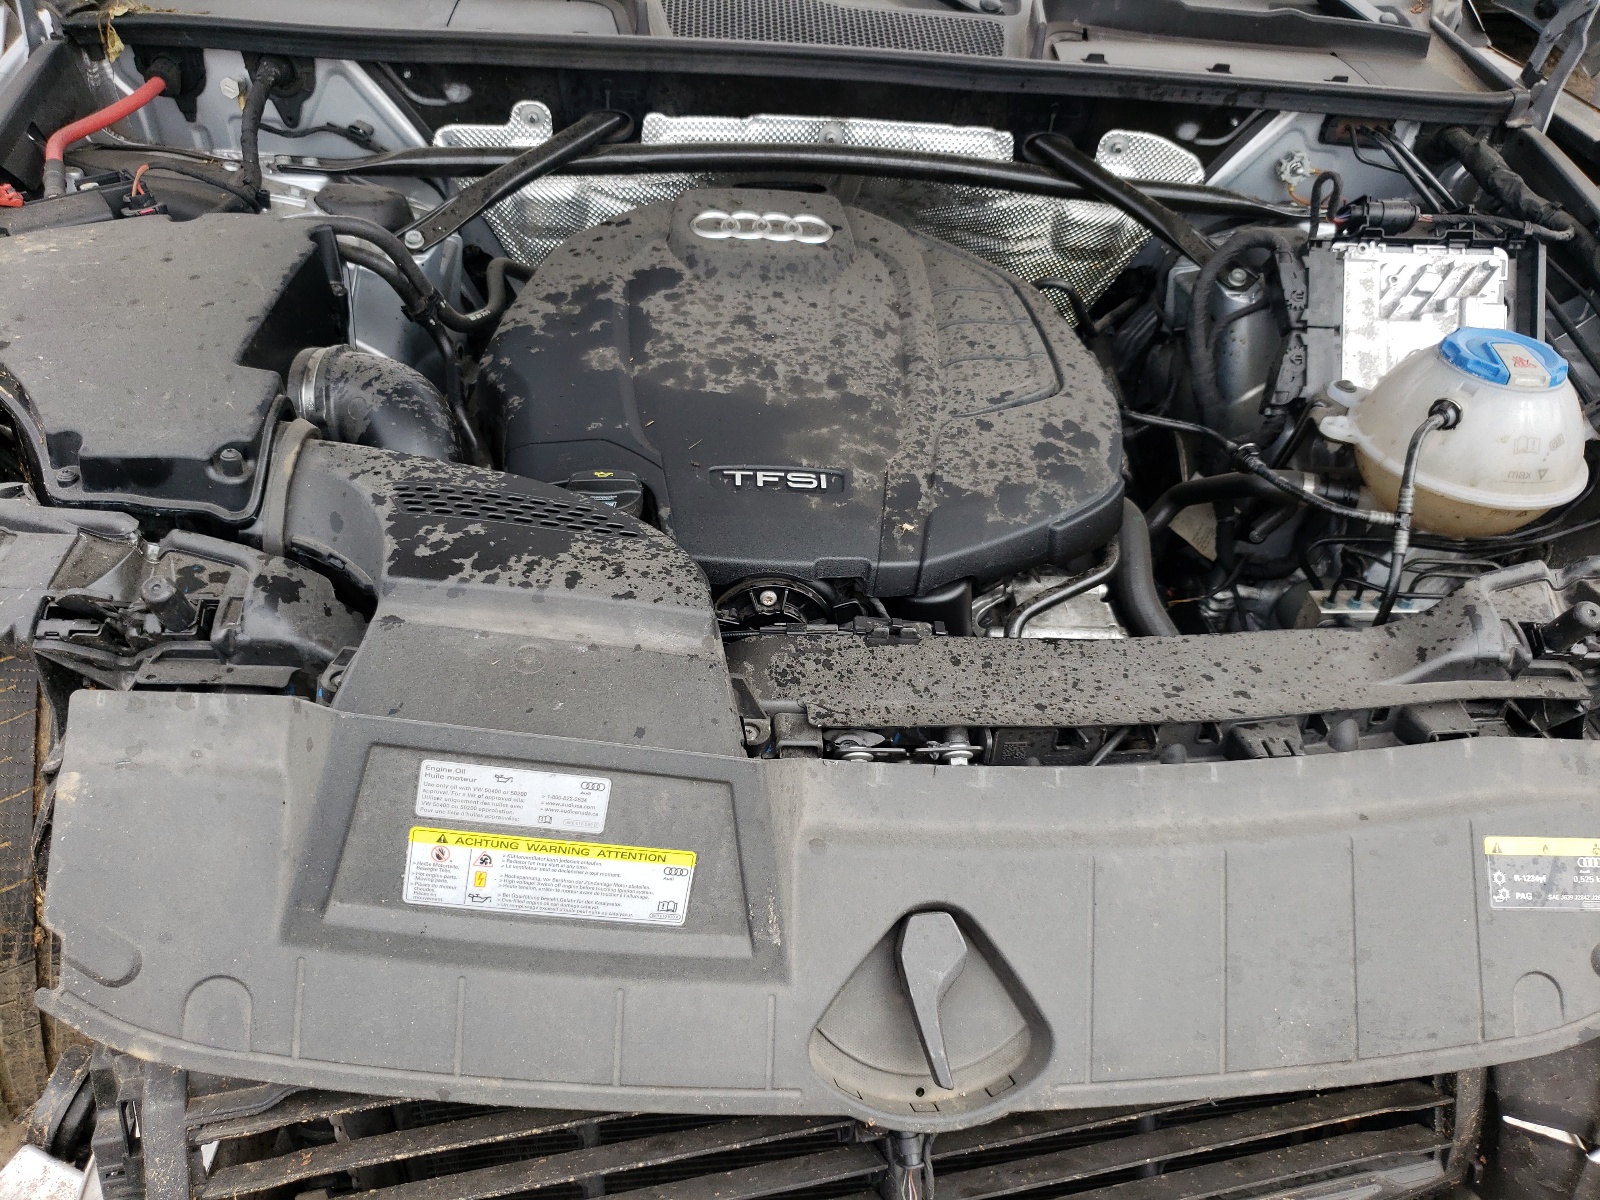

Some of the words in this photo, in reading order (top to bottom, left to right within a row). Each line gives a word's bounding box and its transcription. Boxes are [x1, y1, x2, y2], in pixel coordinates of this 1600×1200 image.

[1508, 470, 1532, 479] max
[723, 470, 827, 489] TFSI
[425, 765, 453, 773] Engine
[447, 775, 478, 783] moteur
[455, 837, 519, 849] ACHTUNG
[527, 843, 590, 856] WARNING
[597, 849, 674, 862] ATTENTION
[1514, 874, 1546, 883] R-1234yf
[1516, 892, 1532, 900] PAG
